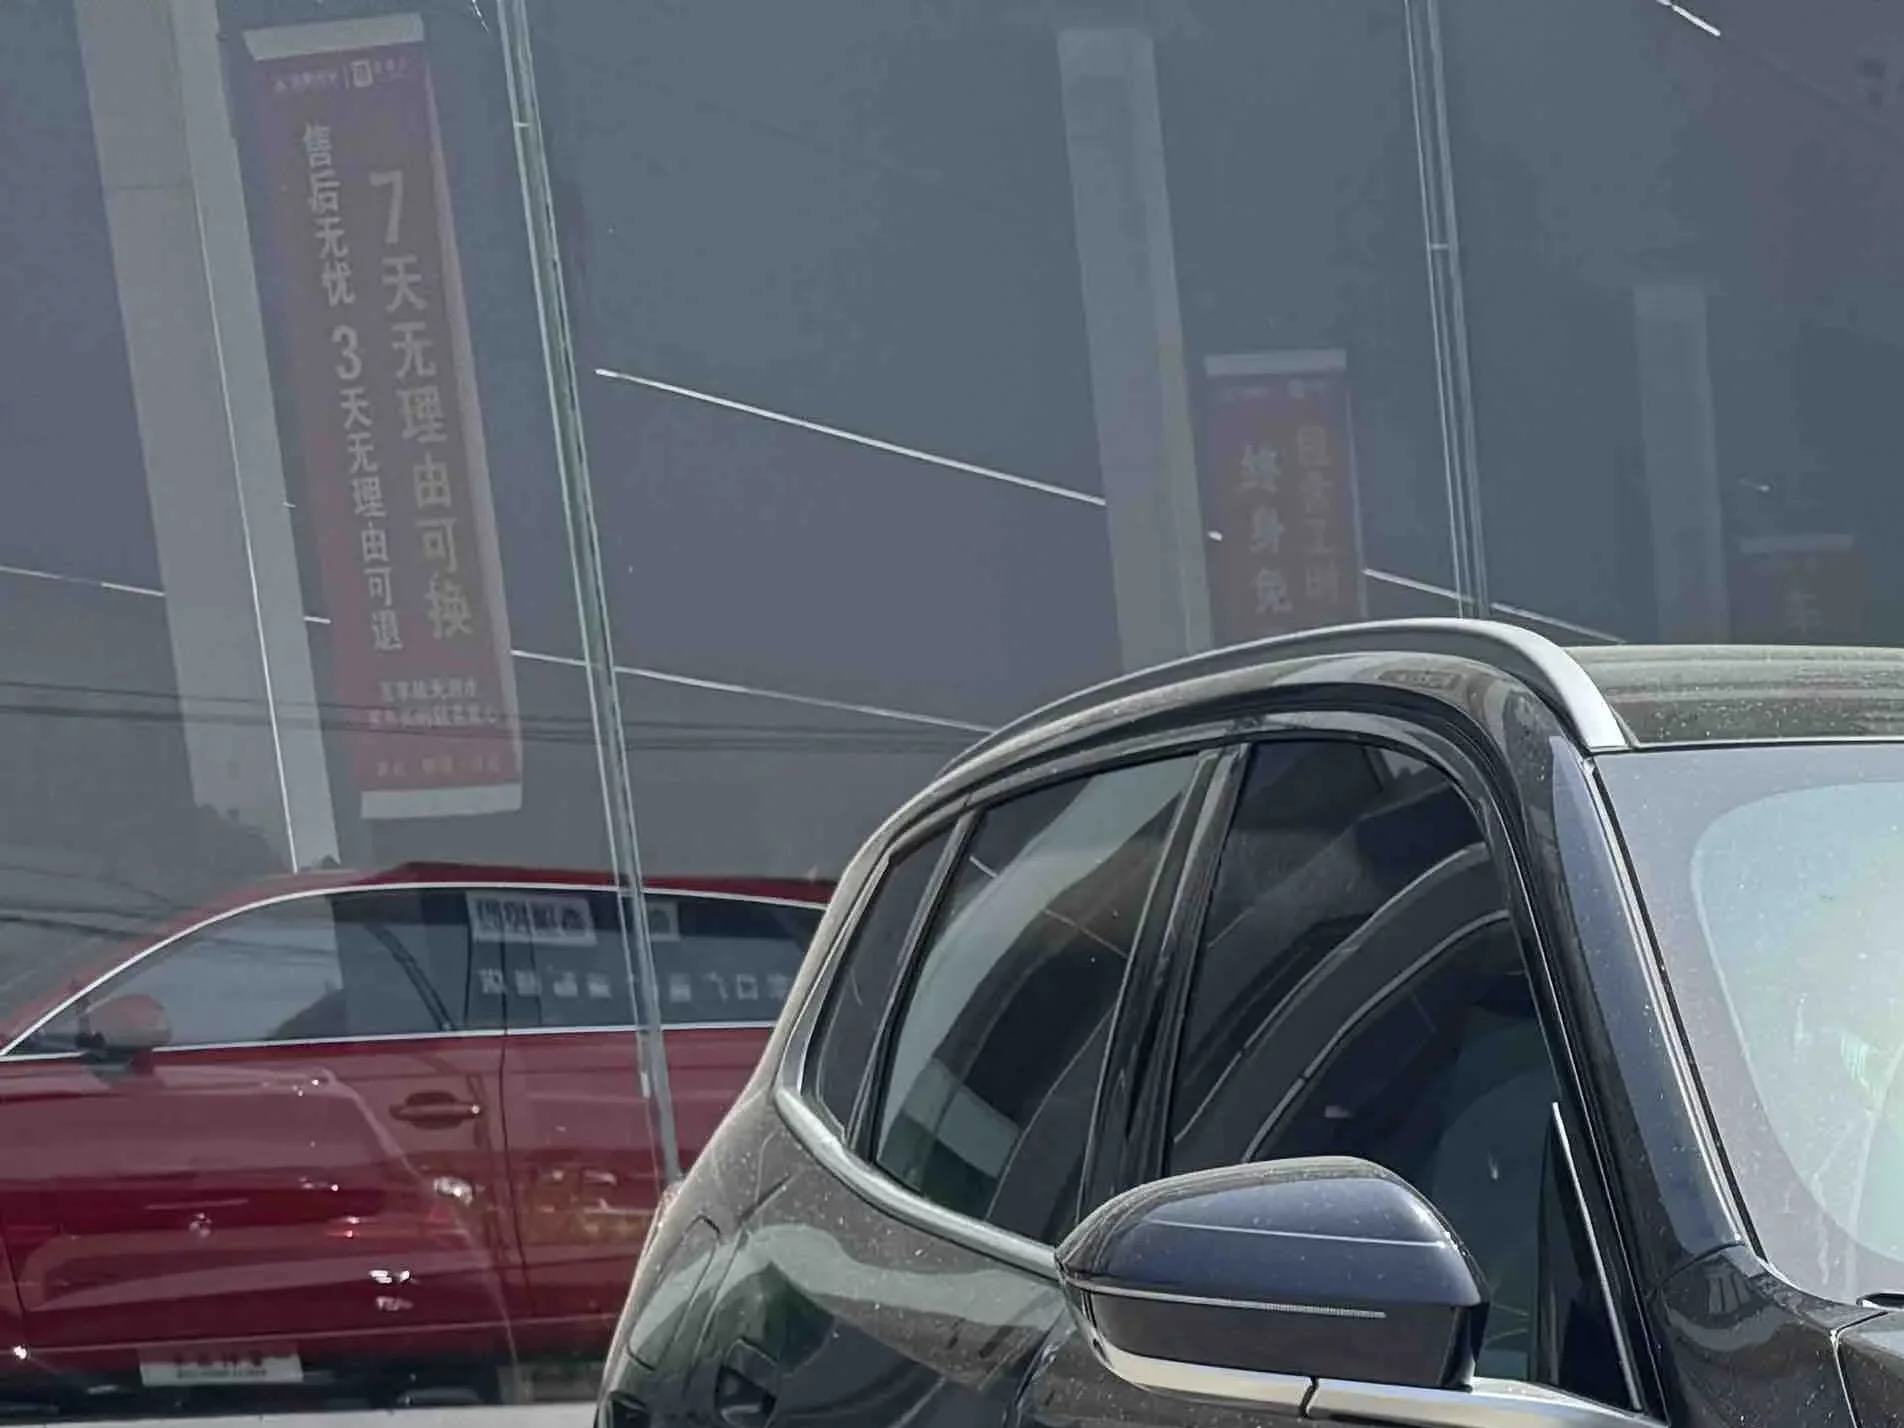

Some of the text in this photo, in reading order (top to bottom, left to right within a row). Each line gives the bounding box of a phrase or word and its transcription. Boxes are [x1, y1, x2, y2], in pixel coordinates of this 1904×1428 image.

[302, 121, 356, 307] 售后无忧
[330, 325, 404, 651] 3天无理由可退
[368, 170, 474, 641] 7天无理由可换
